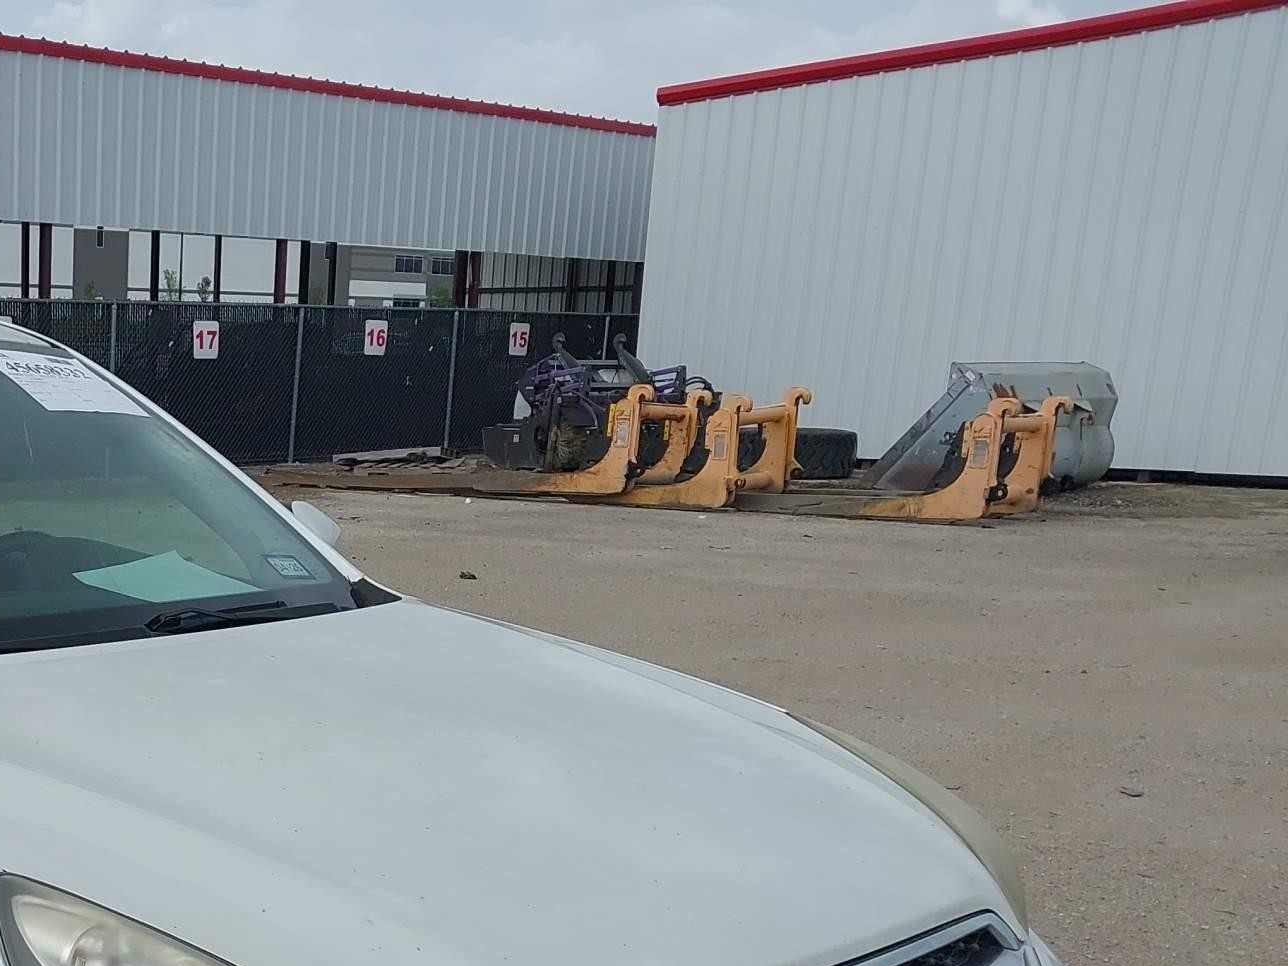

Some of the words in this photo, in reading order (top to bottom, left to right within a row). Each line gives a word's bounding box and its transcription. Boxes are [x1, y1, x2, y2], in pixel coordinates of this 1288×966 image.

[196, 330, 217, 349] 17
[367, 329, 385, 347] 16
[512, 331, 527, 348] 15
[5, 361, 91, 379] 45658332
